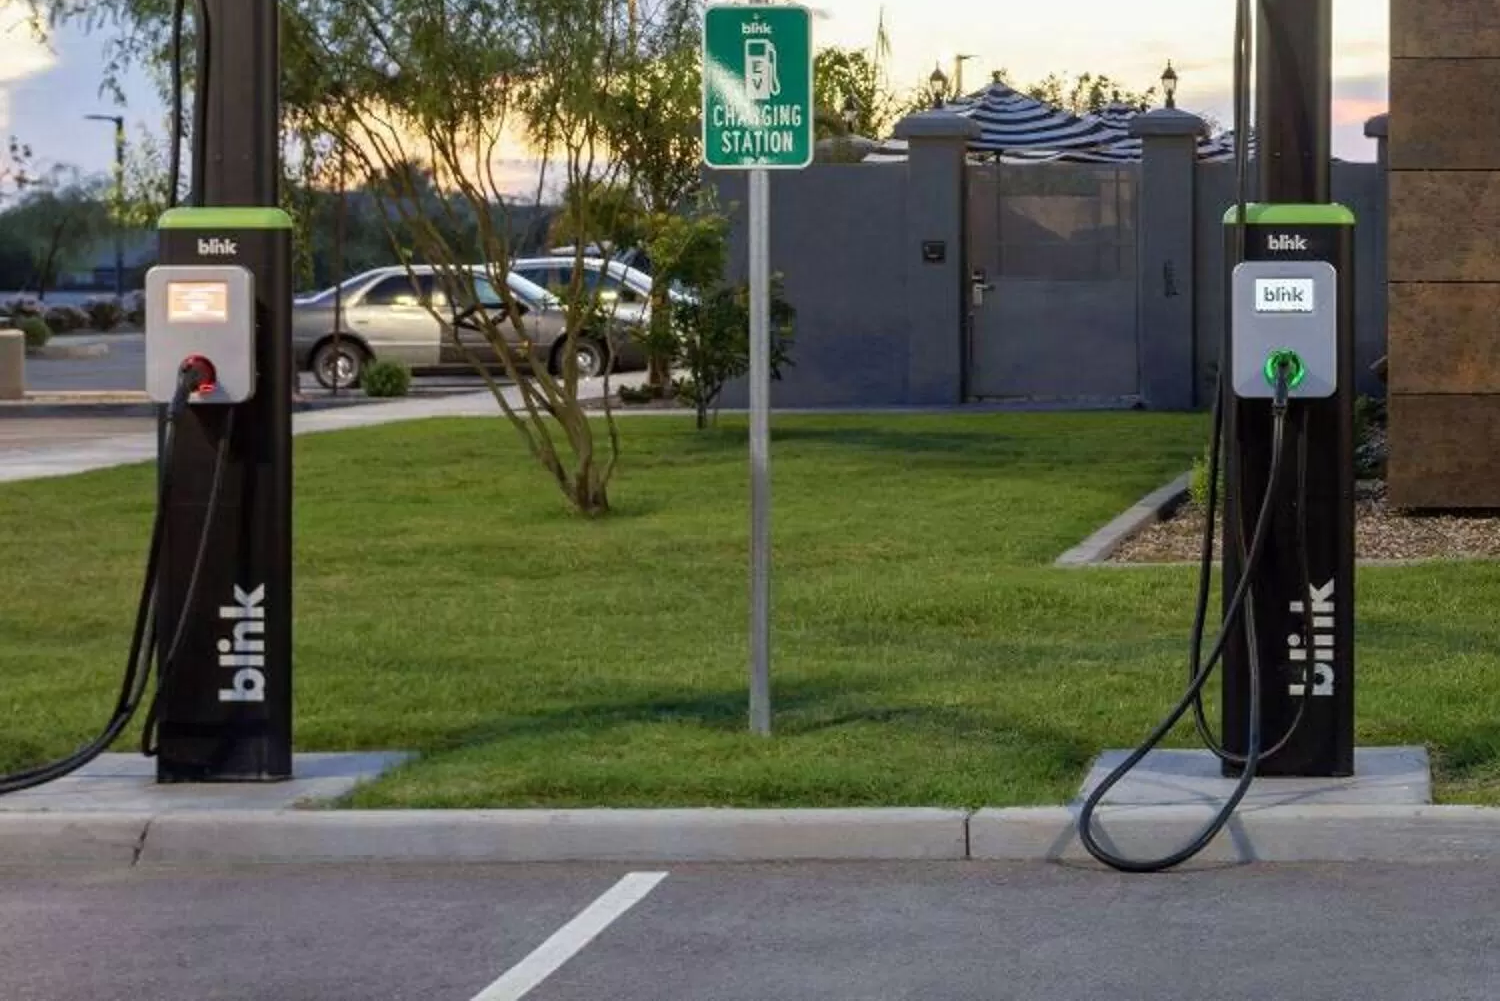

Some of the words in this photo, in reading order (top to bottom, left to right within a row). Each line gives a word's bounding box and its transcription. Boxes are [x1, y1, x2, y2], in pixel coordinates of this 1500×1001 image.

[741, 22, 772, 34] blink
[713, 104, 802, 126] CHARGING
[721, 131, 793, 152] STATION
[197, 238, 236, 255] blink
[1267, 234, 1308, 251] blink
[1263, 287, 1305, 303] blink
[217, 583, 265, 701] blink
[1287, 577, 1335, 696] blink
